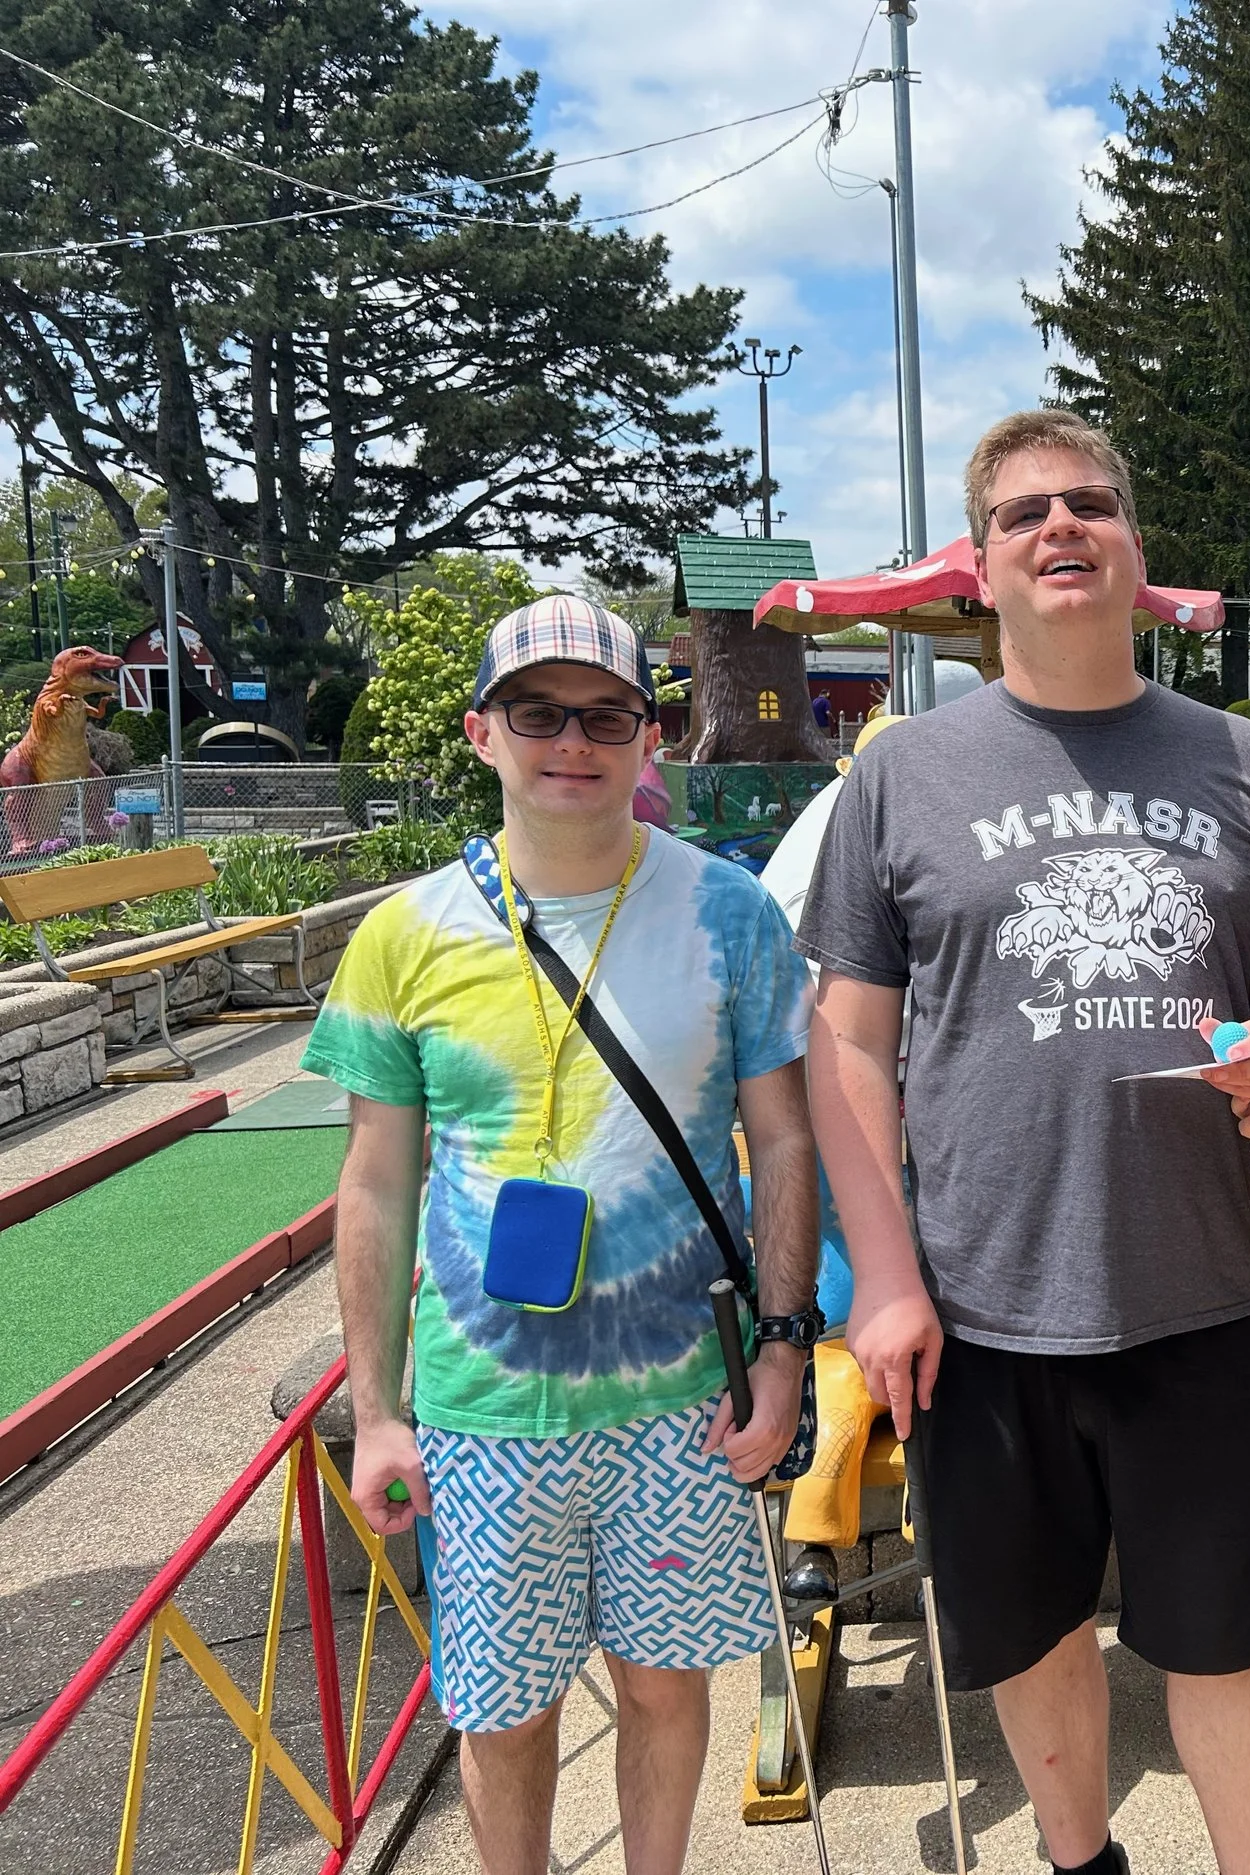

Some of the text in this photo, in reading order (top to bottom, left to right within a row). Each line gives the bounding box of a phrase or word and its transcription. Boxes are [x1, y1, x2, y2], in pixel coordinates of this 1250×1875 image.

[970, 790, 1222, 862] M-NASR
[613, 883, 628, 909] SOAR
[520, 953, 534, 982] SOAR
[1074, 997, 1155, 1030] STATE
